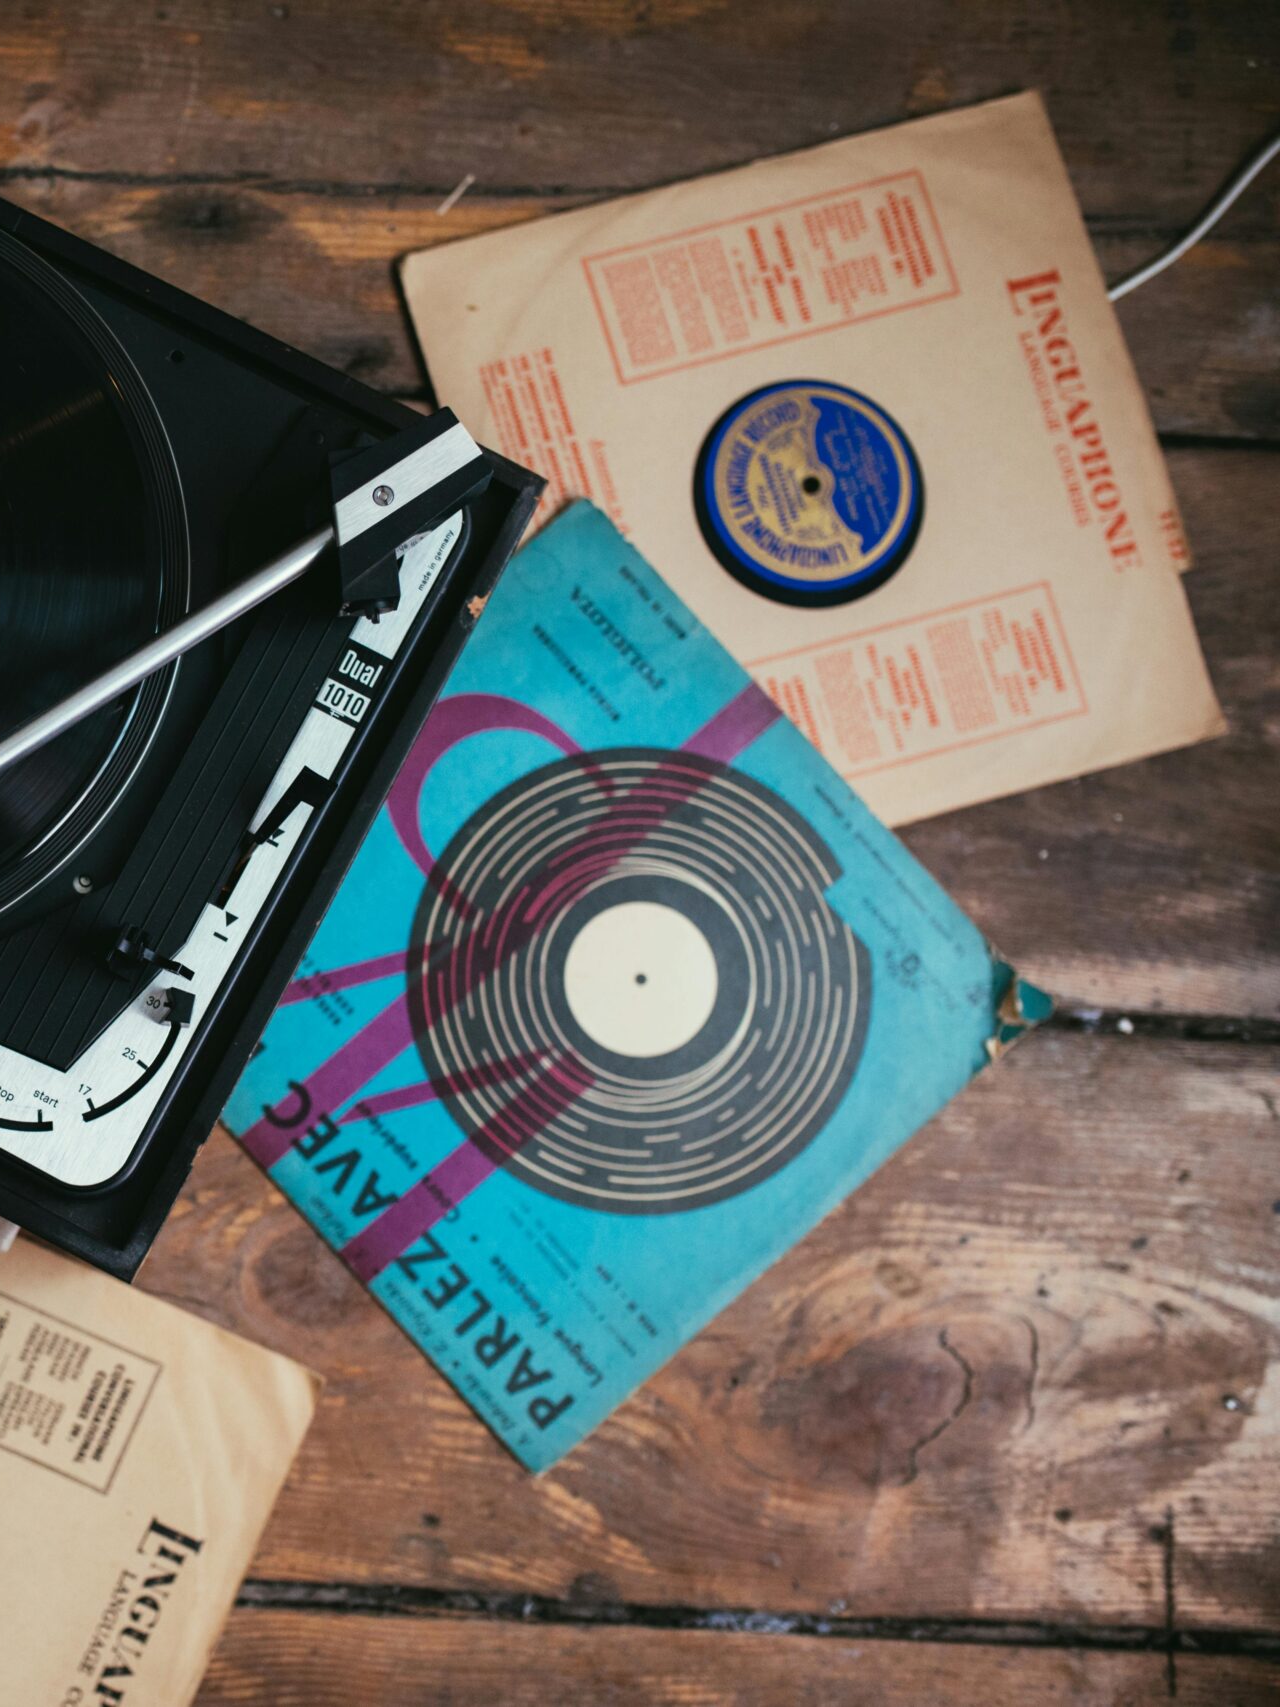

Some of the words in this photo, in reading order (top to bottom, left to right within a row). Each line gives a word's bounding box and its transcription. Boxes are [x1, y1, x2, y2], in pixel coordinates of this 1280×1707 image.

[1005, 265, 1143, 574] LINGUAPHONE
[1018, 329, 1062, 434] LANGUAGE
[1052, 441, 1092, 528] COURSES
[418, 570, 433, 592] made
[434, 528, 455, 562] germany
[338, 649, 384, 689] Dual
[568, 588, 664, 688] POLIGLOTA
[323, 683, 365, 717] 1010
[145, 995, 162, 1010] 30
[121, 1047, 138, 1061] 25
[32, 1087, 60, 1108] start
[77, 1083, 92, 1096] 17
[260, 1079, 395, 1228] AVEC
[414, 1172, 463, 1225] Cours
[395, 1229, 572, 1430] PARLEZ
[548, 1324, 606, 1387] Langue
[76, 1366, 121, 1461] CONVERSATIONAL
[93, 1380, 132, 1459] LINGUAPHONE
[76, 1567, 137, 1679] LANGUAGE
